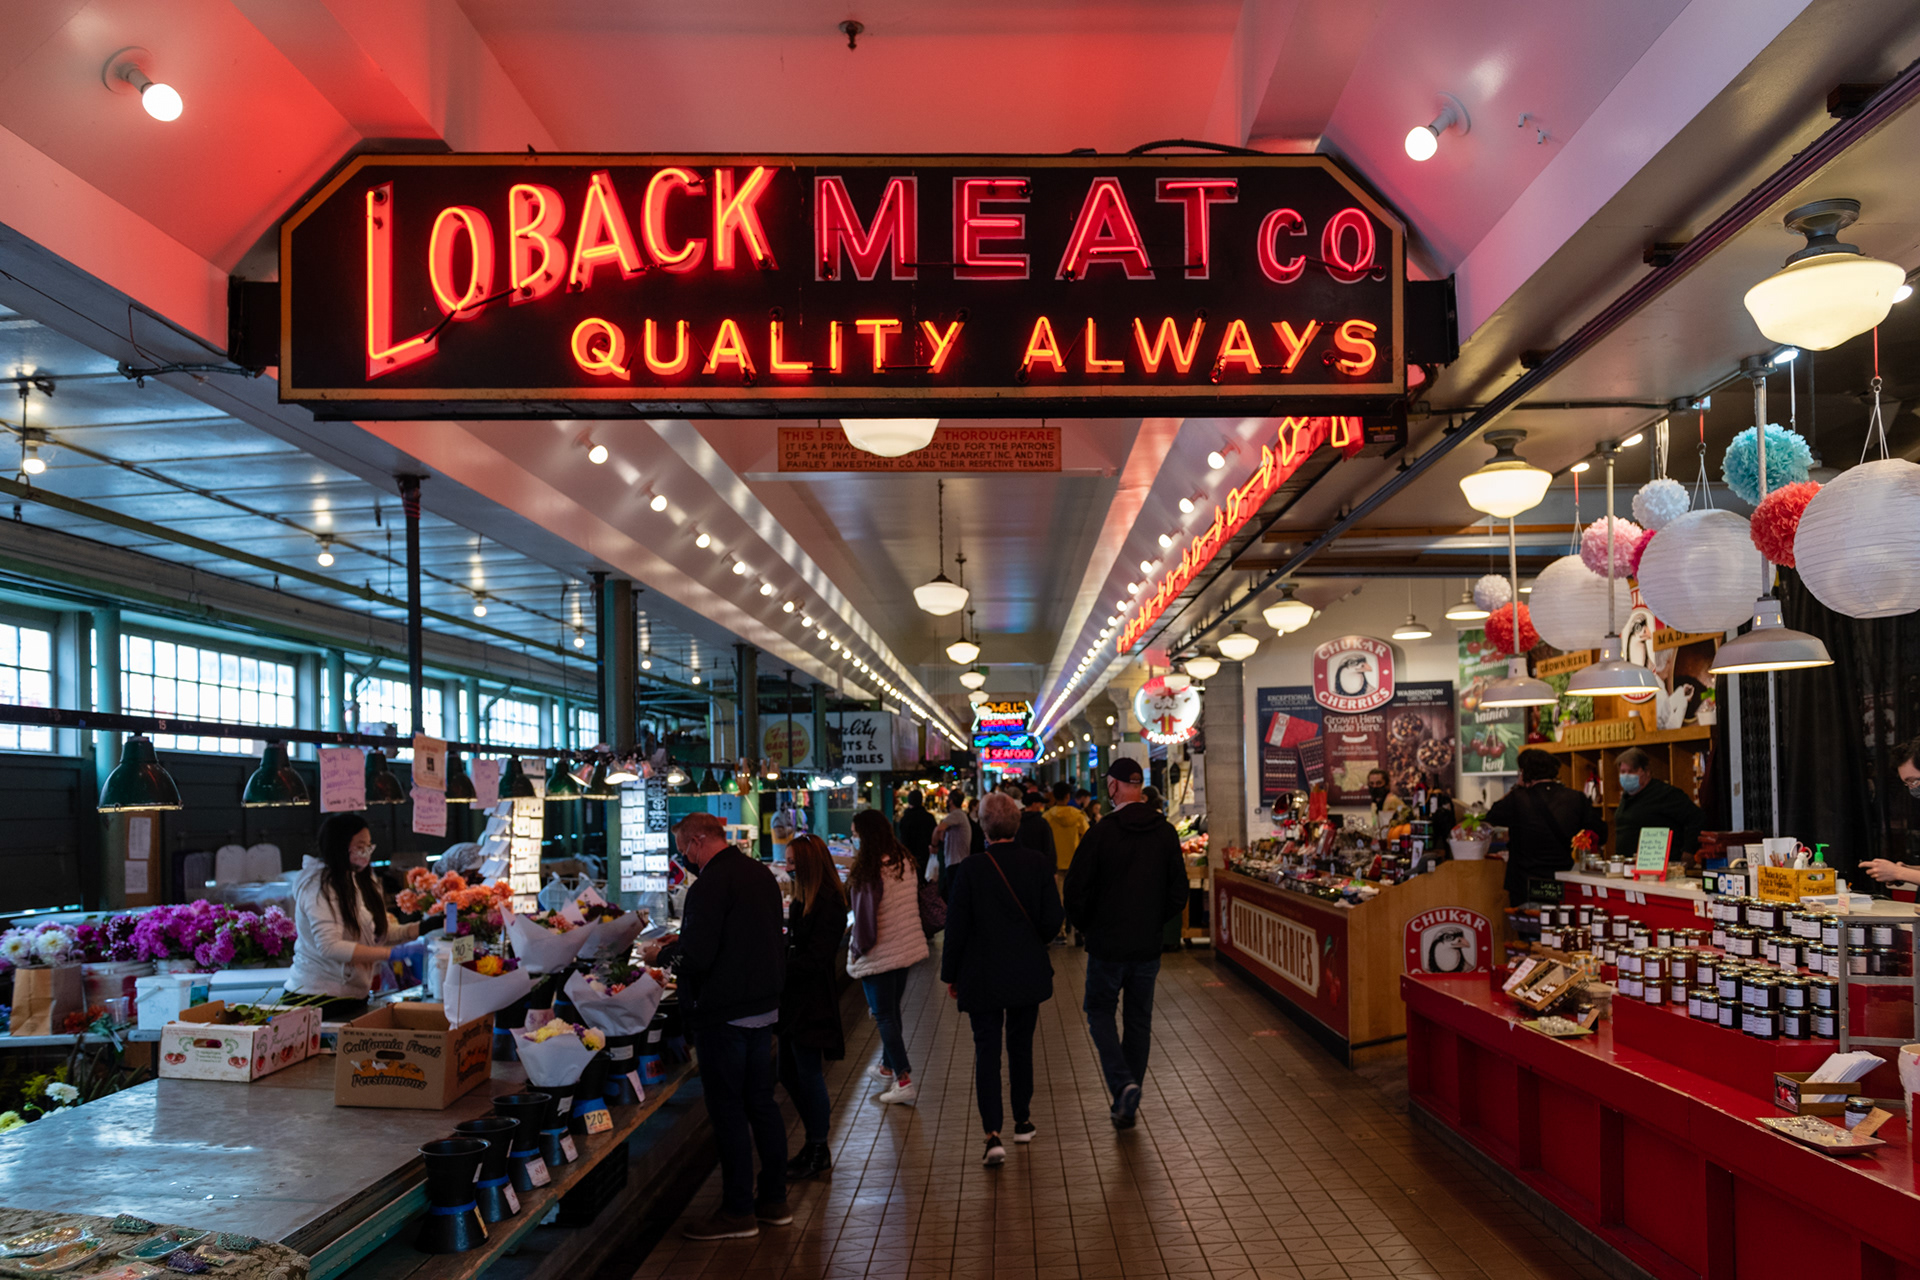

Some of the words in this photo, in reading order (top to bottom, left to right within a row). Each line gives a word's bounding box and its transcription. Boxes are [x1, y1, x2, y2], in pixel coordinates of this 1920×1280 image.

[814, 175, 1238, 282] MEAT
[571, 317, 964, 380] QUALITY
[1020, 316, 1379, 377] ALWAYS
[784, 431, 814, 442] THIS
[820, 431, 834, 442] IS
[944, 431, 1055, 441] THOROUGHFARE
[786, 443, 795, 451] IT
[798, 443, 808, 451] IS
[811, 443, 818, 451] A
[821, 443, 855, 451] PRIVA
[964, 443, 985, 451] FOR
[989, 443, 1007, 451] THE
[1010, 443, 1055, 451] PATRONS
[785, 452, 800, 460] OF
[806, 452, 826, 460] THE
[831, 452, 858, 460] PIKE
[909, 451, 946, 460] PUBLIC
[951, 452, 992, 460] MARKET
[1014, 452, 1030, 460] AND
[1034, 452, 1053, 460] THE
[787, 461, 828, 469] FAIRLEY
[832, 461, 893, 469] INVESTMENT
[917, 461, 935, 469] AND
[1318, 640, 1387, 660] CHUKAR
[1567, 654, 1588, 667] HERE
[1318, 687, 1390, 710] CHERRIES
[1396, 688, 1444, 697] WASHINGTON
[1324, 715, 1357, 726] Grown
[1359, 714, 1385, 724] Here.
[1328, 724, 1355, 733] Made
[1356, 723, 1382, 732] Here.
[1596, 721, 1636, 743] CHERRIES
[1146, 729, 1190, 744] PRODUCE
[868, 740, 878, 751] &
[991, 749, 1034, 760] SEAFOOD
[1482, 756, 1504, 773] king
[1410, 909, 1486, 932] CHUKAR
[1266, 917, 1313, 986] CHERRIES
[343, 1039, 404, 1054] California
[406, 1040, 442, 1058] Fresh
[352, 1072, 428, 1091] Persimmons
